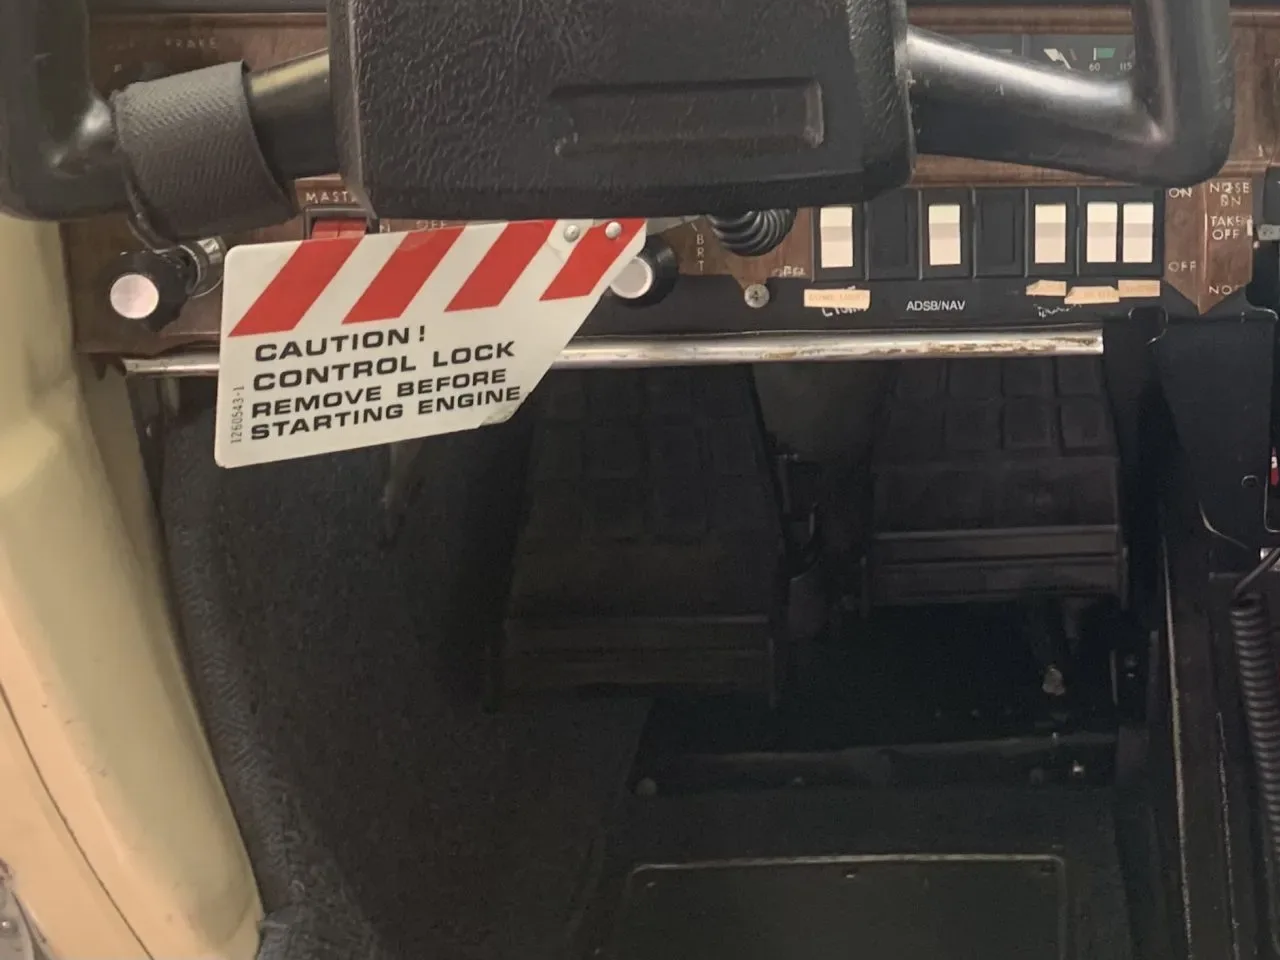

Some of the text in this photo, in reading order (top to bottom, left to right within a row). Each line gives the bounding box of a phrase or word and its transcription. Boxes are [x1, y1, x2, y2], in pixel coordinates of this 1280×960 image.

[1168, 186, 1193, 199] ON
[1209, 181, 1250, 194] NOSE
[1212, 228, 1241, 241] OFF
[1168, 260, 1197, 273] OFF
[906, 299, 966, 313] ADSB/NAV
[252, 340, 516, 392] CONTROL LOCK
[251, 368, 507, 419] REMOVE BEFORE
[251, 385, 521, 441] STARTING ENGINE
